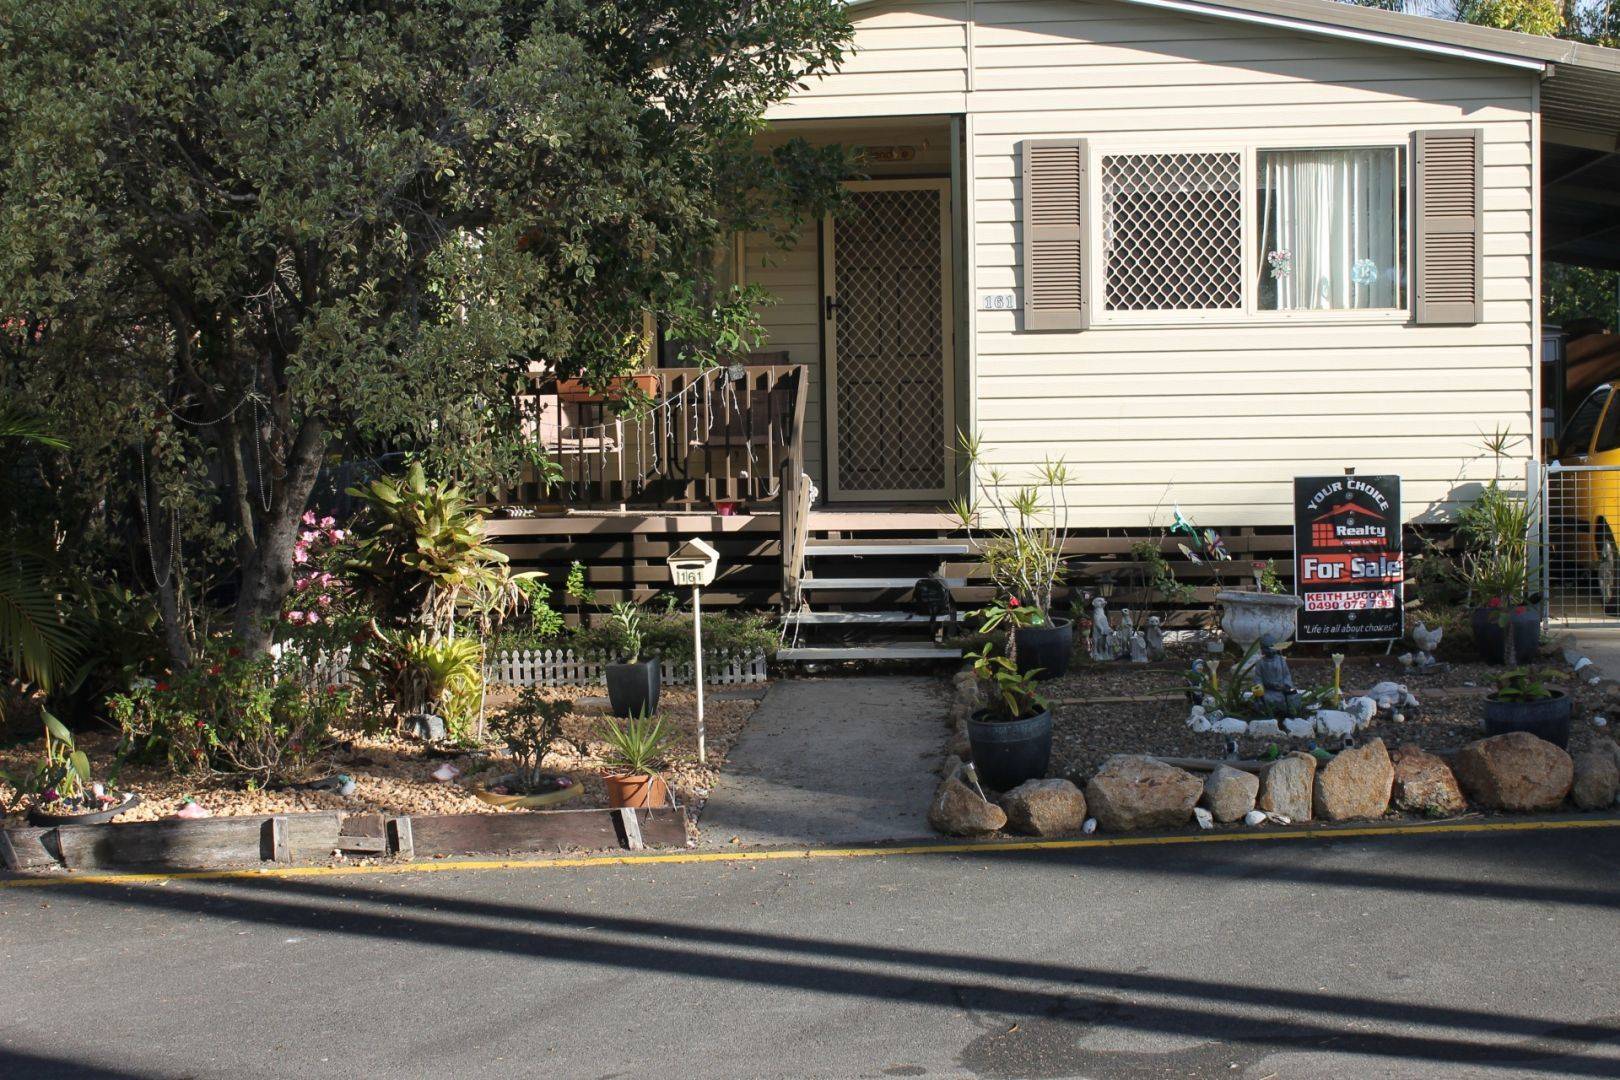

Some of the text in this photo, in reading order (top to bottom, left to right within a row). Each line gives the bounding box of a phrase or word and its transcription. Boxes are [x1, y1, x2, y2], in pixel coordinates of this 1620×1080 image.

[984, 295, 1013, 309] 161
[1307, 480, 1389, 511] YOUR CHOICE
[1336, 525, 1385, 537] Realty
[1304, 556, 1401, 579] For Sale
[681, 572, 702, 582] 161
[1307, 593, 1342, 602] KEITH
[1308, 602, 1339, 610] 0490
[1343, 601, 1366, 609] 075
[1303, 624, 1321, 633] "Life
[1322, 625, 1331, 633] is
[1331, 624, 1340, 632] all
[1341, 624, 1365, 632] about
